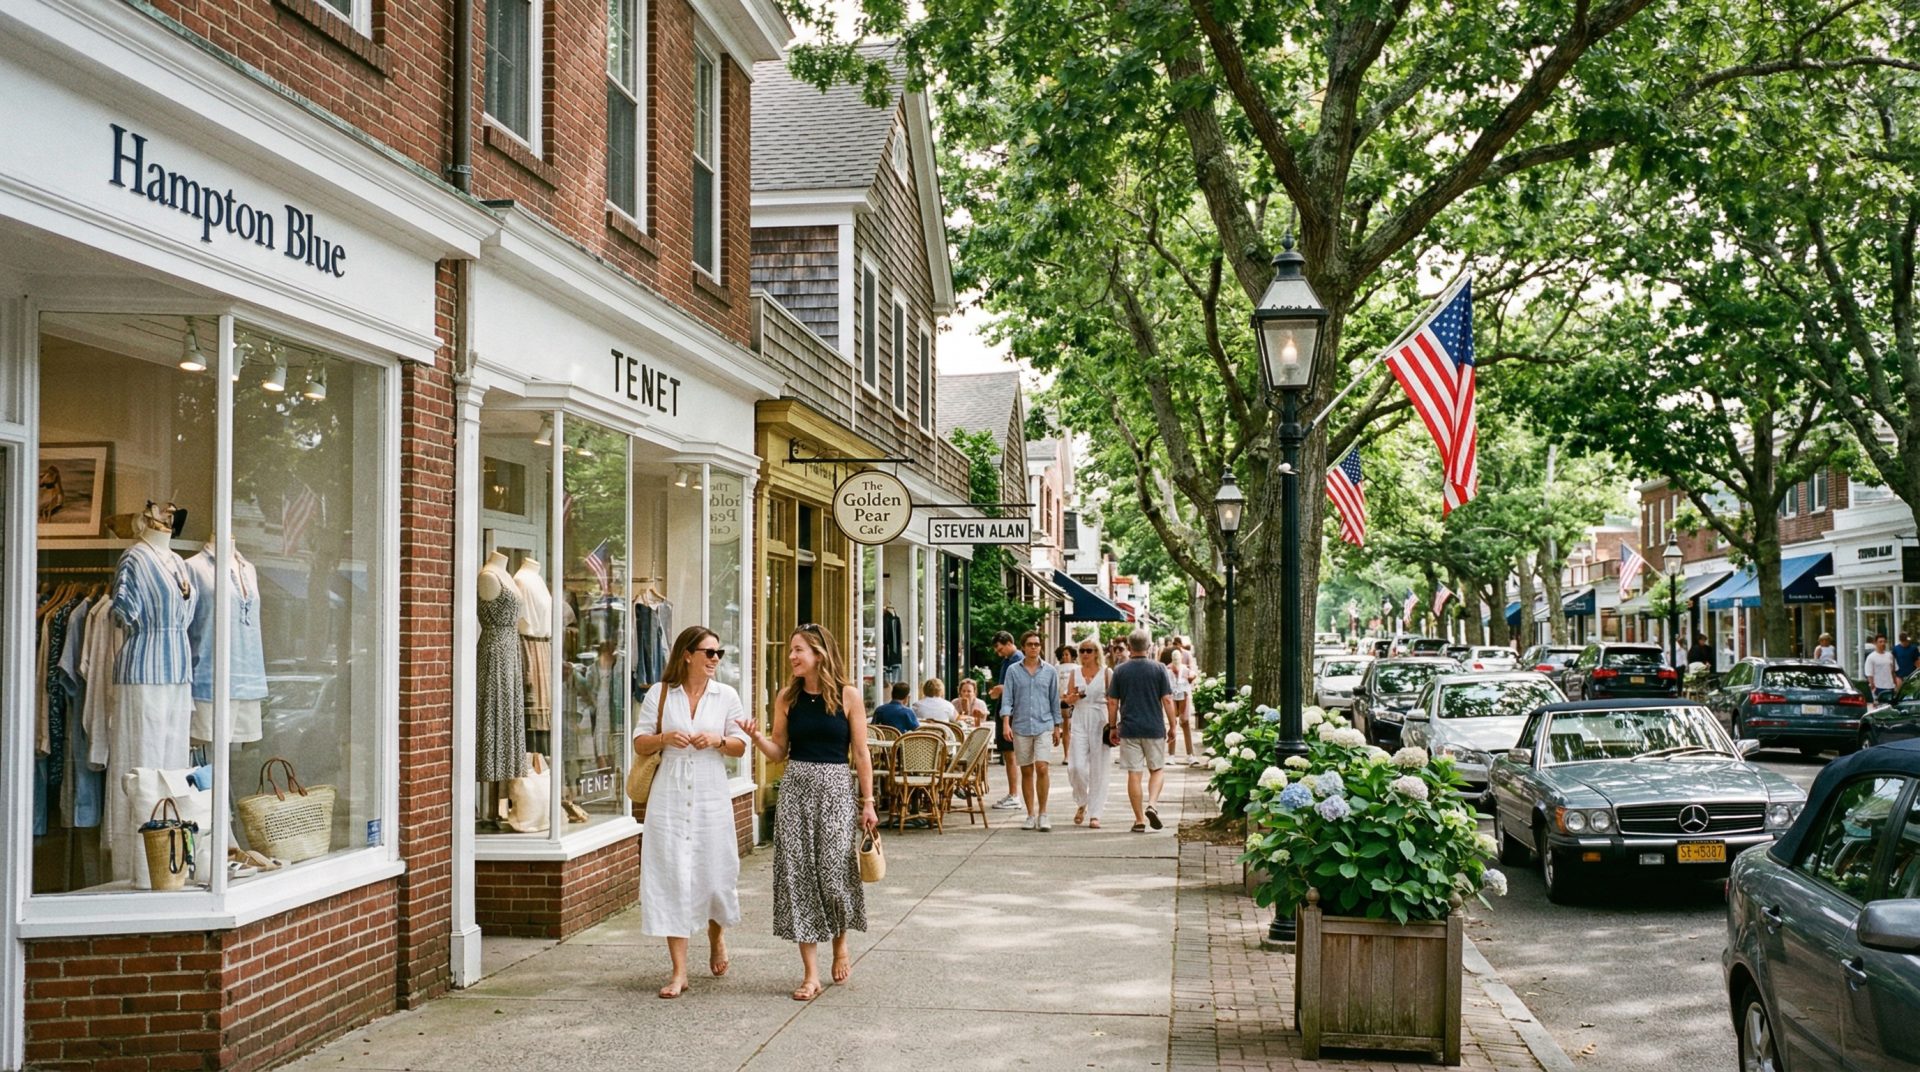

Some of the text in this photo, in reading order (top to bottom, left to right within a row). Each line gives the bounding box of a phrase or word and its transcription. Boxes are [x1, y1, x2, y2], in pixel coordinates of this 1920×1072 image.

[109, 123, 346, 278] Hampton Blue
[610, 348, 681, 417] TENET
[862, 481, 883, 491] The
[843, 492, 902, 507] Golden
[854, 508, 891, 522] Pear
[859, 525, 884, 535] Cafe
[934, 523, 1024, 538] STEVEN ALAN
[579, 773, 616, 795] TENET
